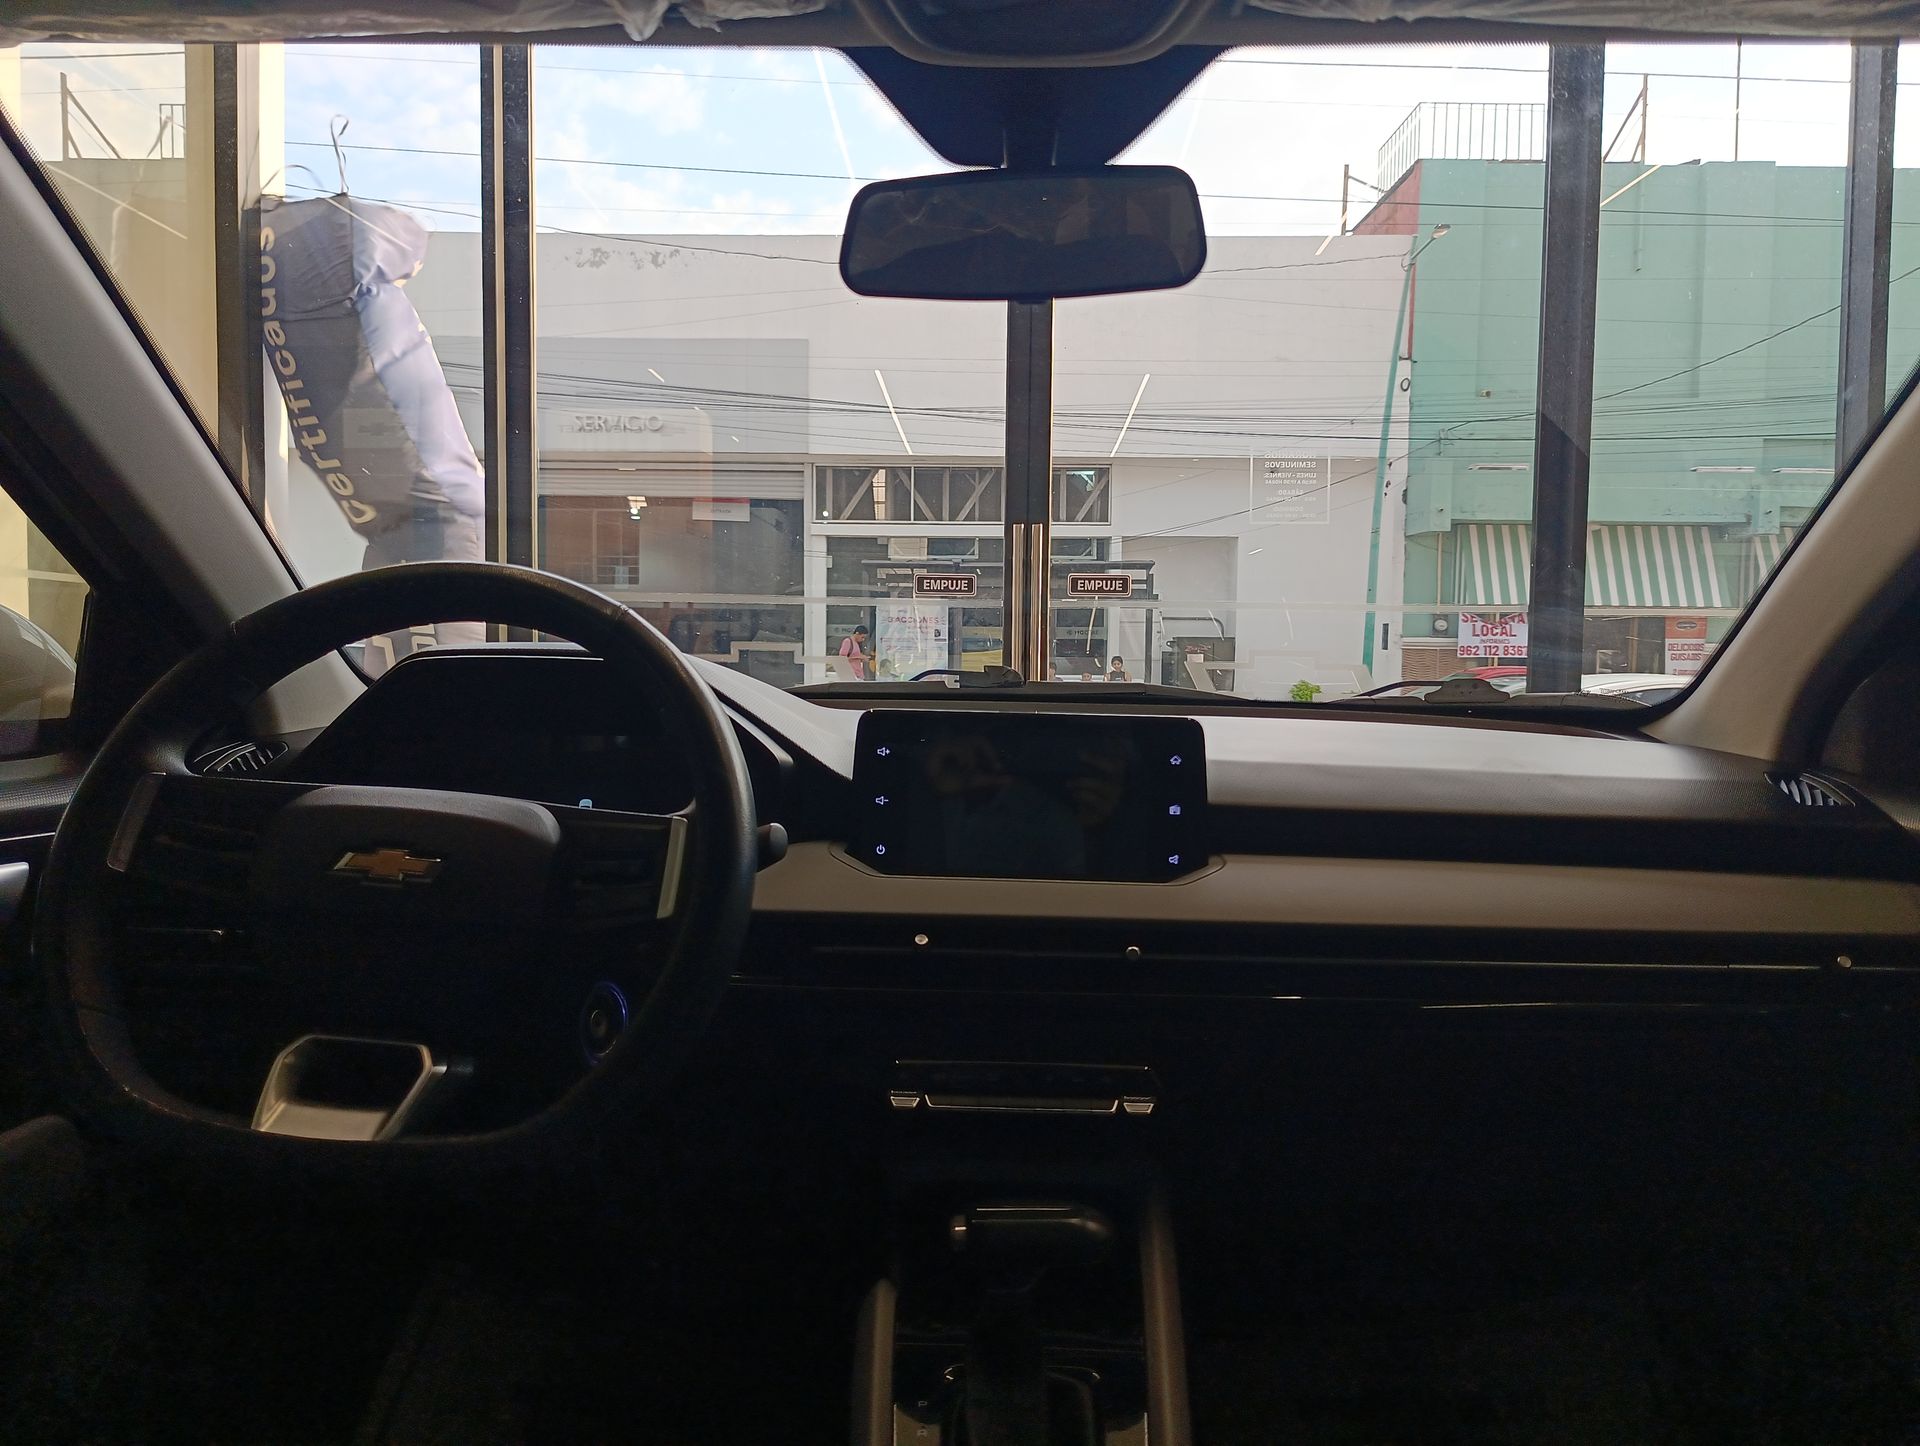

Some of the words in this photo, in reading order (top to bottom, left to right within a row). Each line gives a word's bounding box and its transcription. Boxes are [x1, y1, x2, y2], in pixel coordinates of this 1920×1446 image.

[575, 415, 664, 433] SERVICIO
[923, 579, 969, 591] EMPUJE
[1077, 579, 1123, 592] EMPUJE
[1461, 613, 1478, 623] SE
[1472, 624, 1517, 637] LOCAL
[1459, 645, 1480, 656] 962
[1483, 645, 1499, 656] 112
